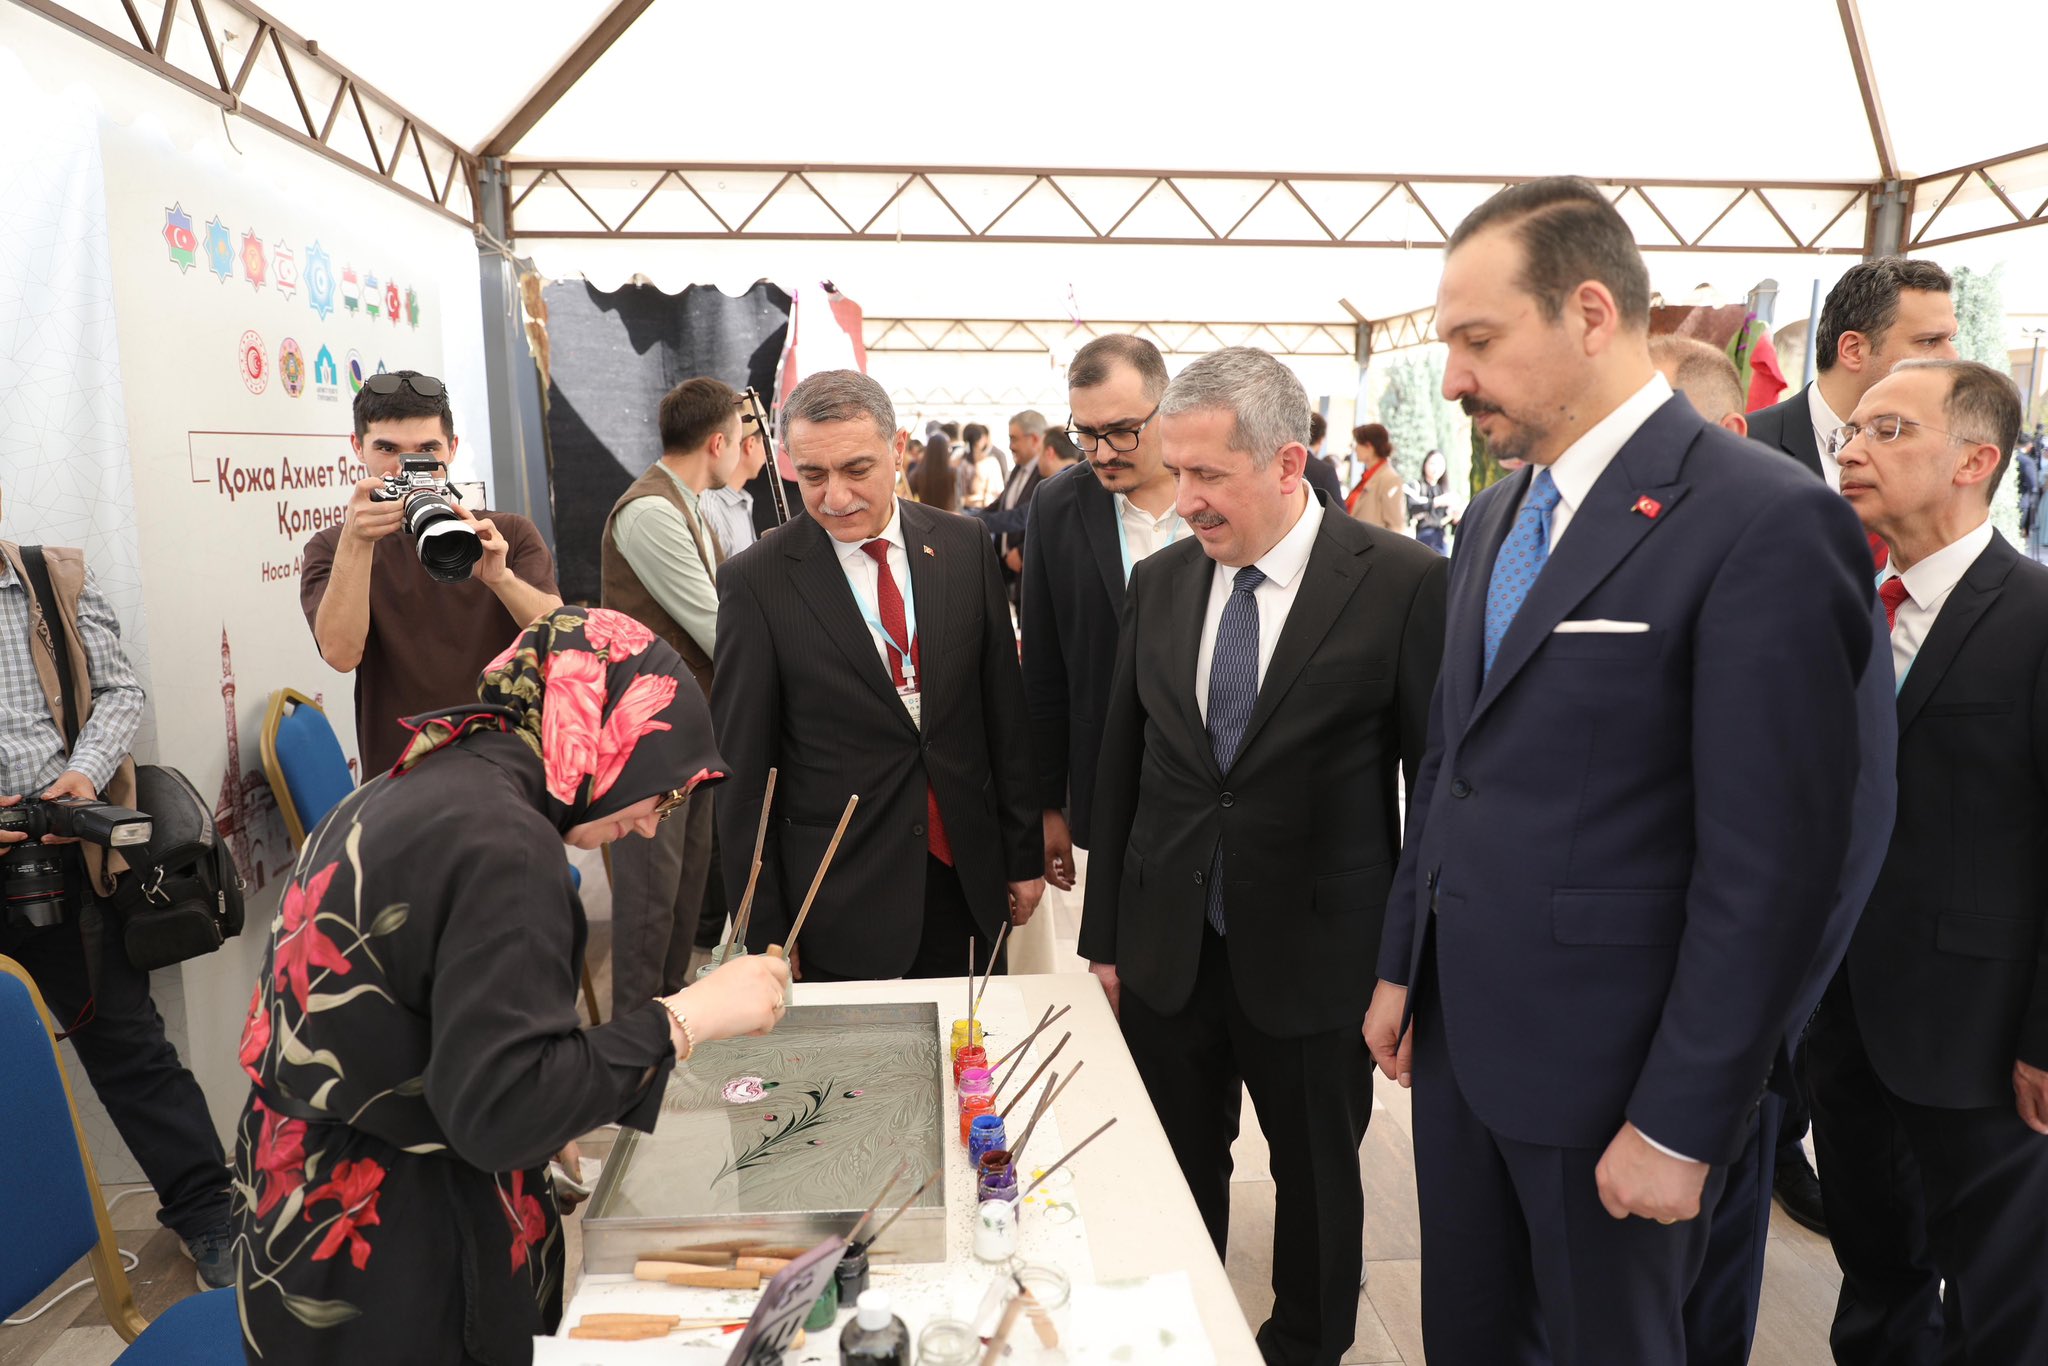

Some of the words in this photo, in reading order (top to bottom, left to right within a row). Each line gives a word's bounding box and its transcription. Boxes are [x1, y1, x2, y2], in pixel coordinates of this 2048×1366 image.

[217, 457, 275, 501] Қожа
[281, 457, 334, 490] Ахмет
[262, 561, 290, 582] Hoca
